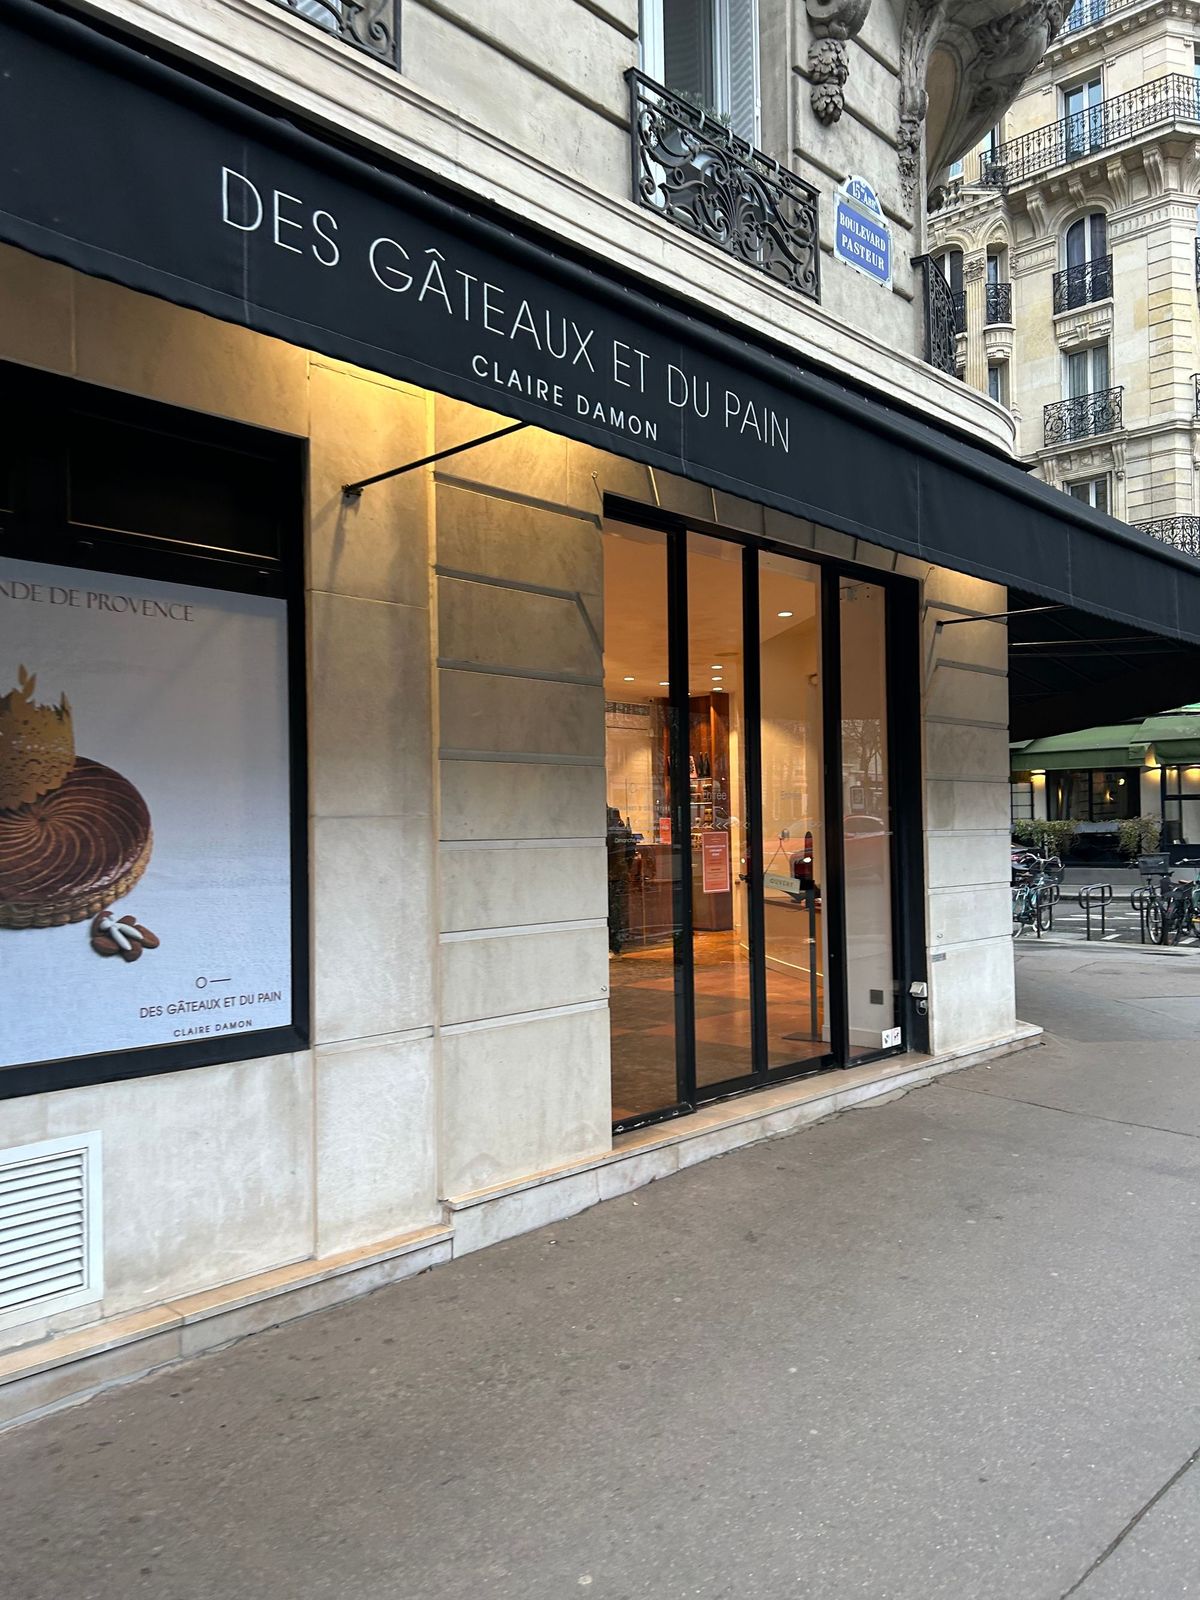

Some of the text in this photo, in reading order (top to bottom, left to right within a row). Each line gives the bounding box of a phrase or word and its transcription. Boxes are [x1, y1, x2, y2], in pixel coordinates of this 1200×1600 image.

[839, 212, 886, 252] BOULEVARD
[841, 234, 885, 271] PASTEUR
[221, 166, 791, 454] DES GÂTEAUX ET DU PAIN
[471, 354, 658, 442] CLAIRE DAMON
[49, 586, 81, 608] DE
[86, 591, 195, 622] PROVENCE
[139, 990, 282, 1019] DES GÂTEAUX ET DU PAIN
[173, 1019, 253, 1038] CLAIRE DAMON
